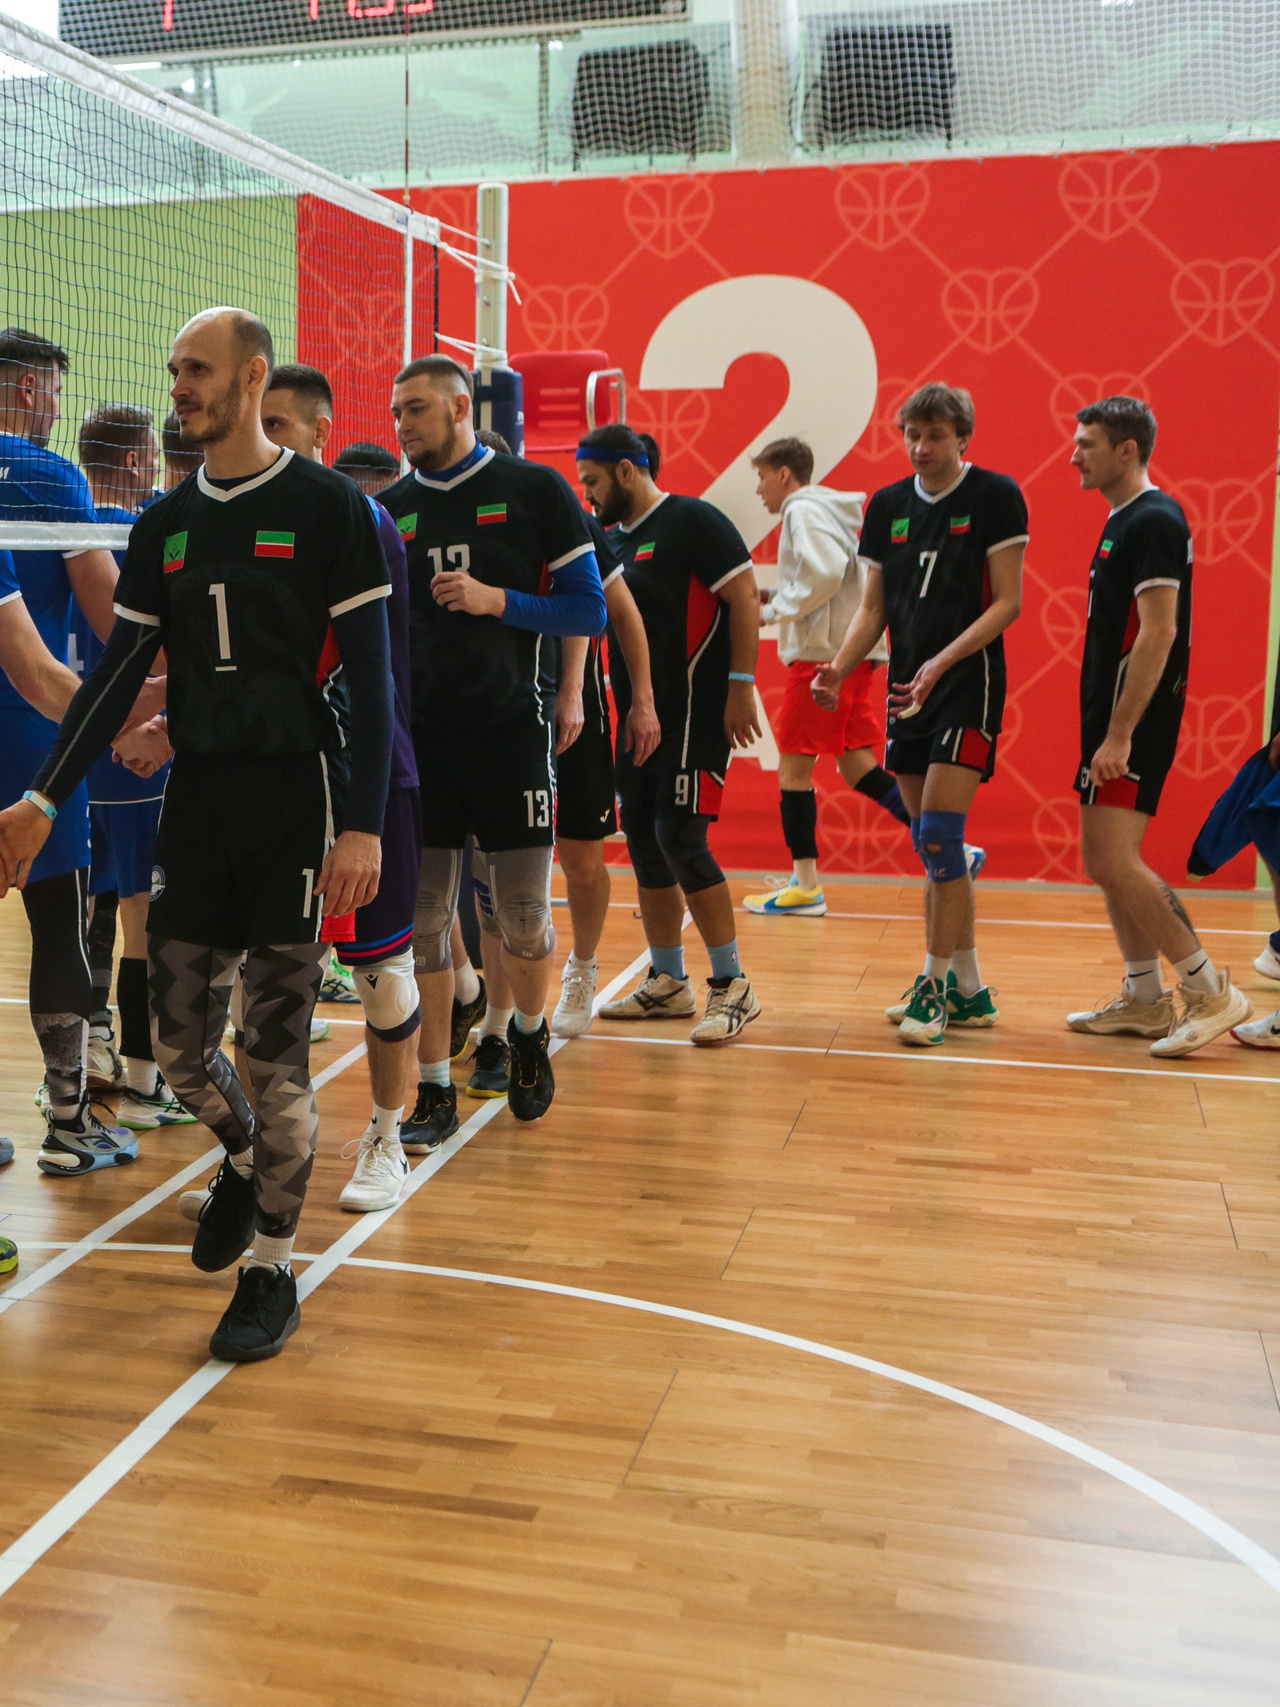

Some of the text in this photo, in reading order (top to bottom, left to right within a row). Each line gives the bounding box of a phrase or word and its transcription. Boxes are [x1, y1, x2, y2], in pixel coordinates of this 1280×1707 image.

[639, 274, 878, 640] 2
[919, 551, 938, 598] 7
[209, 583, 231, 660] 1
[523, 790, 550, 827] 13
[675, 774, 689, 805] 9
[302, 868, 315, 918] 1
